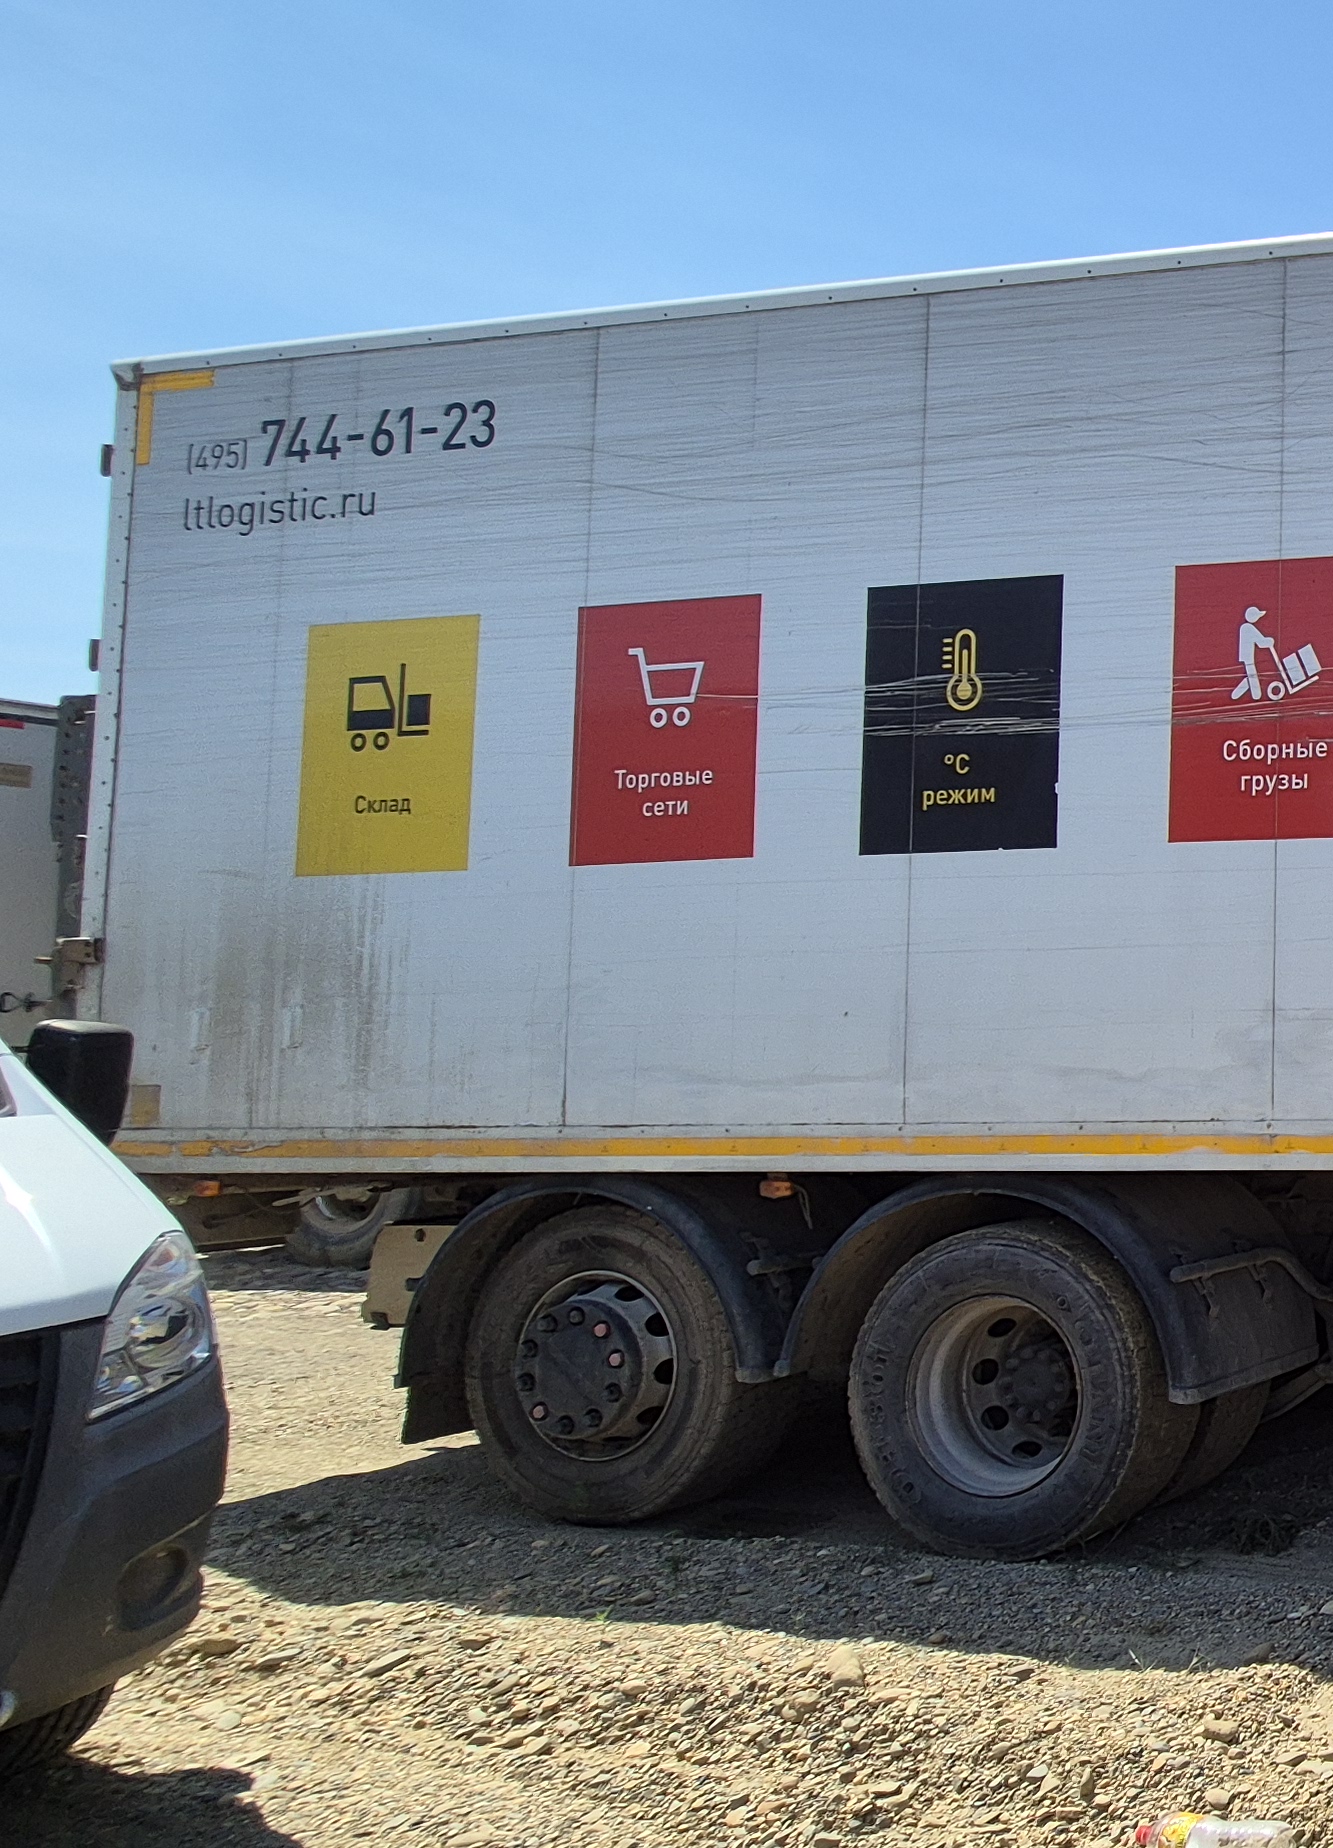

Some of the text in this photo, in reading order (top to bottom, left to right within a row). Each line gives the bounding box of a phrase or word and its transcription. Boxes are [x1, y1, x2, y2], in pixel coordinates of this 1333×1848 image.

[261, 399, 498, 467] 744-61-23
[183, 487, 377, 537] ltlogistic.ru
[1223, 739, 1328, 764] Сборные
[614, 768, 714, 794] Торговые
[1240, 771, 1309, 796] грузы
[354, 795, 411, 815] Склад
[642, 799, 690, 817] сети
[921, 785, 997, 811] режим
